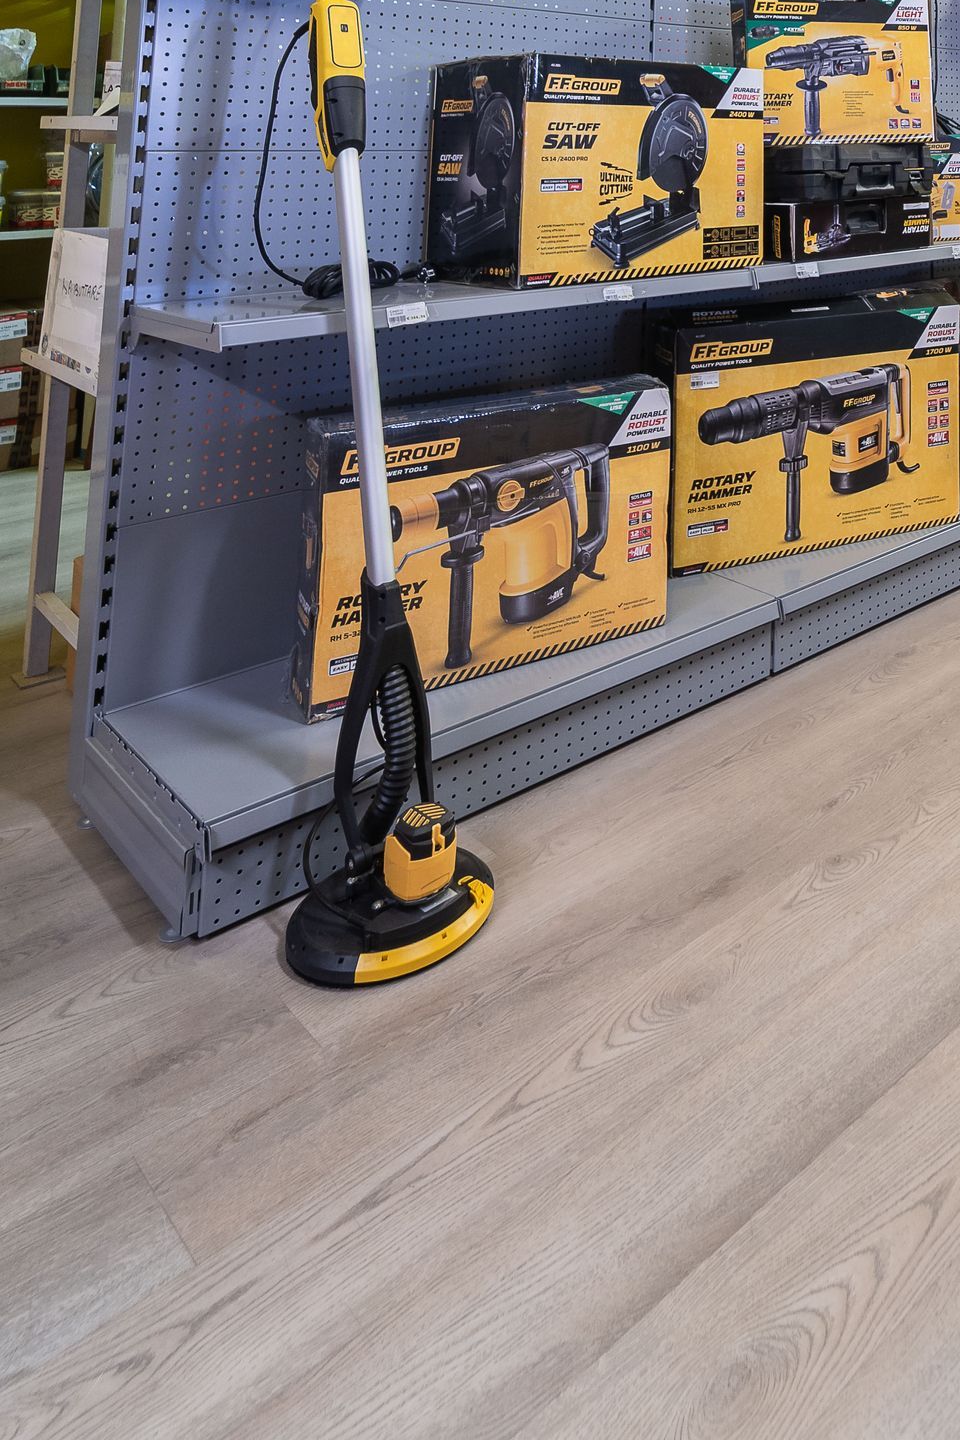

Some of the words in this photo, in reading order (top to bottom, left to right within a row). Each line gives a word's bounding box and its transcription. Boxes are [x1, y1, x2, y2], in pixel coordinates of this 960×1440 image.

[763, 93, 794, 101] OTARY
[547, 122, 601, 132] CUT-OFF
[542, 134, 598, 149] SAW
[440, 154, 464, 162] CUT-OFF
[437, 163, 462, 175] SAW
[600, 172, 633, 182] ULTIMATE
[599, 183, 633, 196] CUTTING
[692, 309, 737, 317] ROTARY
[928, 322, 957, 330] DURABLE
[927, 328, 957, 337] ROBUST
[925, 348, 944, 356] 1700
[630, 409, 668, 421] DURABLE
[627, 417, 667, 430] ROBUST
[626, 426, 665, 437] POWERFUL
[626, 443, 650, 454] 1100
[650, 441, 661, 449] W
[404, 465, 428, 474] TOOLS
[691, 470, 757, 491] ROTARY
[687, 484, 753, 504] HAMMER
[727, 500, 742, 508] PRO
[330, 634, 342, 643] RH
[332, 664, 348, 672] EASY
